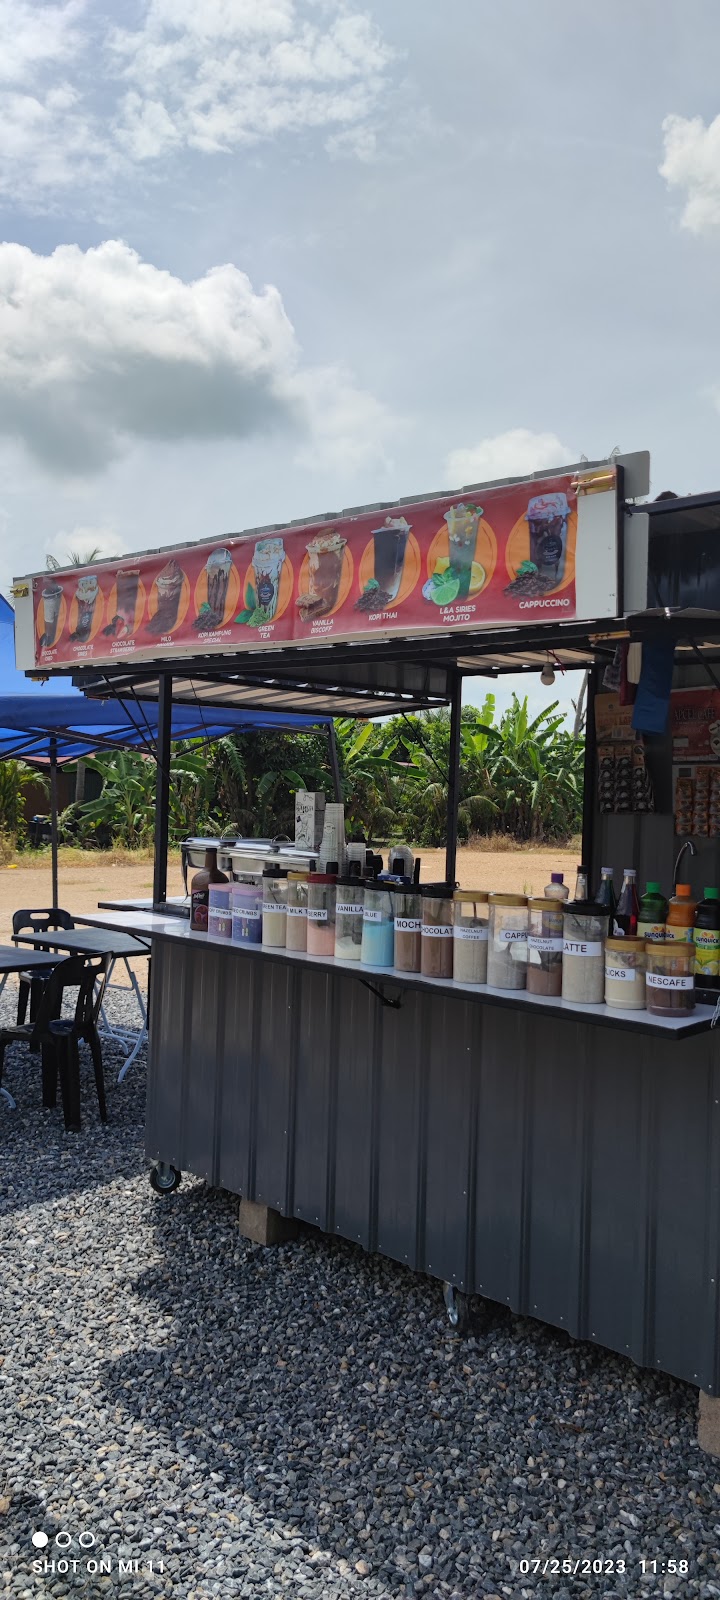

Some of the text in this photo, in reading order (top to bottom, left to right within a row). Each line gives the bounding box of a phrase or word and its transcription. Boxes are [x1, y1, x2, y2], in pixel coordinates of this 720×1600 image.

[519, 598, 570, 609] CAPPUCCINO
[439, 605, 476, 615] L&A SIRIES
[368, 612, 398, 621] KOPI THAI
[443, 613, 470, 622] MOJITO
[312, 619, 334, 627] VANILLA
[209, 629, 232, 637] KAMPUNG
[257, 625, 275, 633] GREEN
[310, 626, 333, 634] BISCOFF
[160, 635, 172, 643] MILO
[111, 639, 136, 648] CHOCOLATE
[289, 907, 303, 915] MILK
[337, 904, 364, 913] VANILLA
[365, 911, 378, 919] BLUE
[421, 926, 453, 935] HOCOLAT
[695, 936, 720, 944] SUNQUICK
[648, 975, 687, 987] NESCAFE
